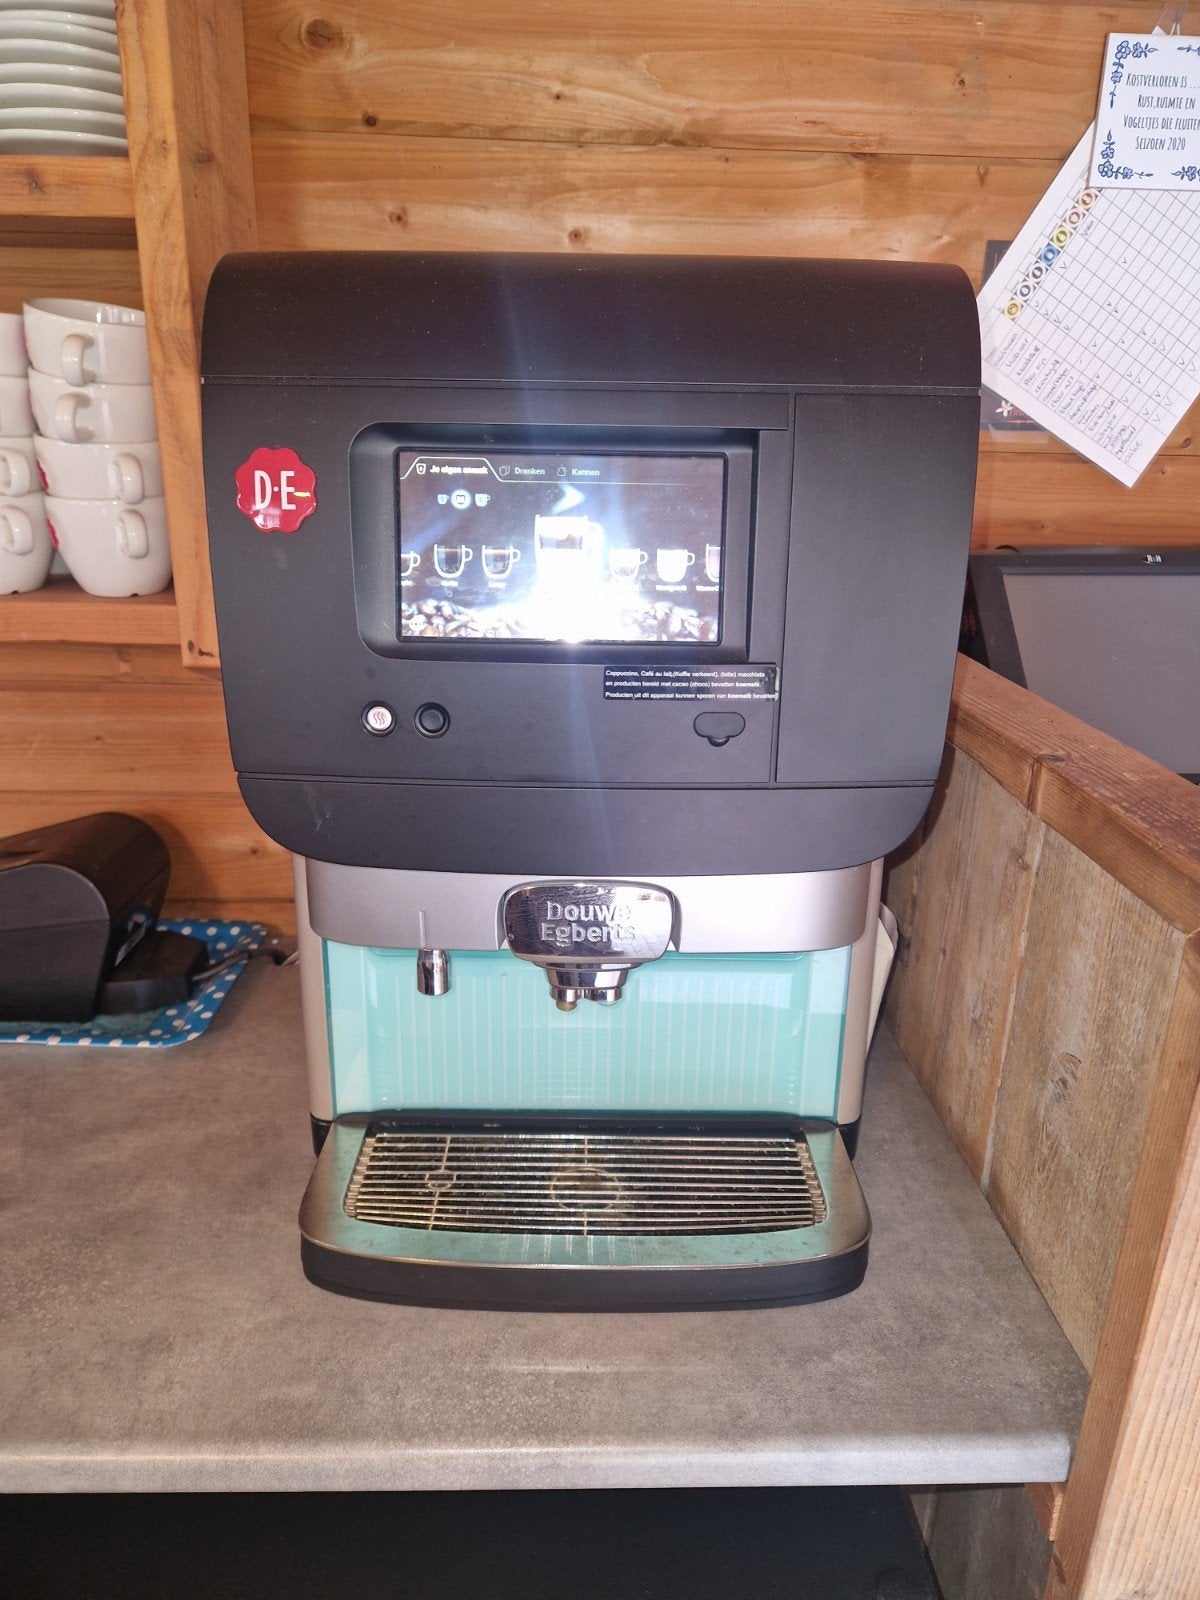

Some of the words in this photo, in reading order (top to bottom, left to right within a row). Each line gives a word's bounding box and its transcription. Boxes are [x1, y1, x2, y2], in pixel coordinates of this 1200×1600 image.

[1167, 137, 1186, 150] 2020
[515, 467, 545, 476] Dranken
[572, 468, 600, 476] Kannen
[605, 669, 640, 677] Cappuccino,
[547, 901, 631, 922] Douwe
[541, 922, 636, 947] Egberts
